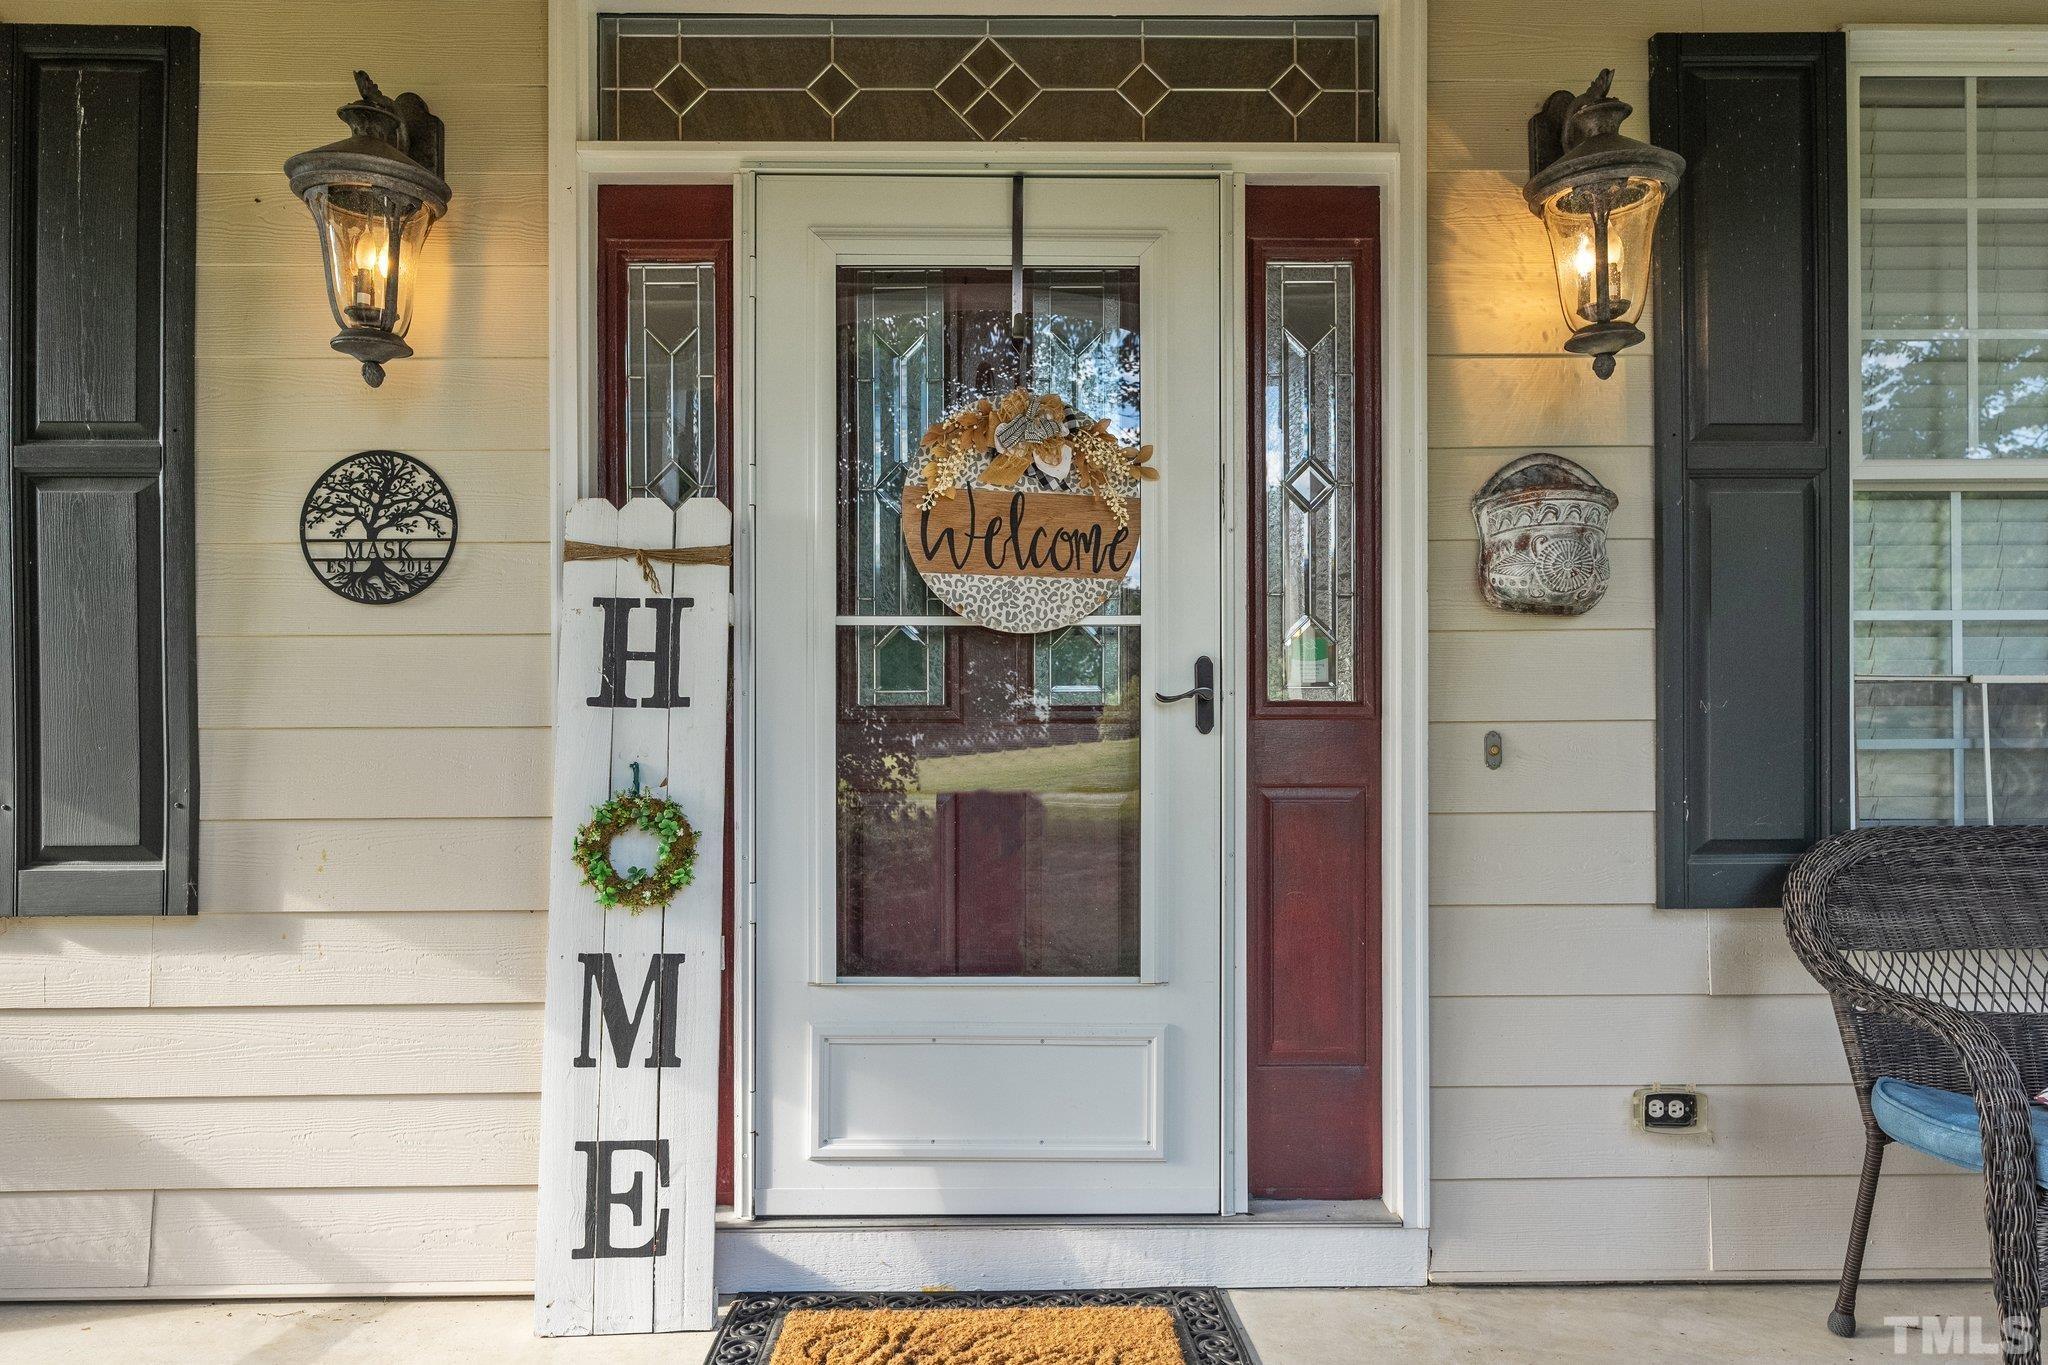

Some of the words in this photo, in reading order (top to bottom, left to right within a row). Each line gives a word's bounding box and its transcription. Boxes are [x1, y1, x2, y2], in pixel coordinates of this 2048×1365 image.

[920, 481, 1131, 574] Welcome
[344, 540, 414, 559] MASK
[326, 560, 357, 573] EST
[399, 560, 434, 573] 2014
